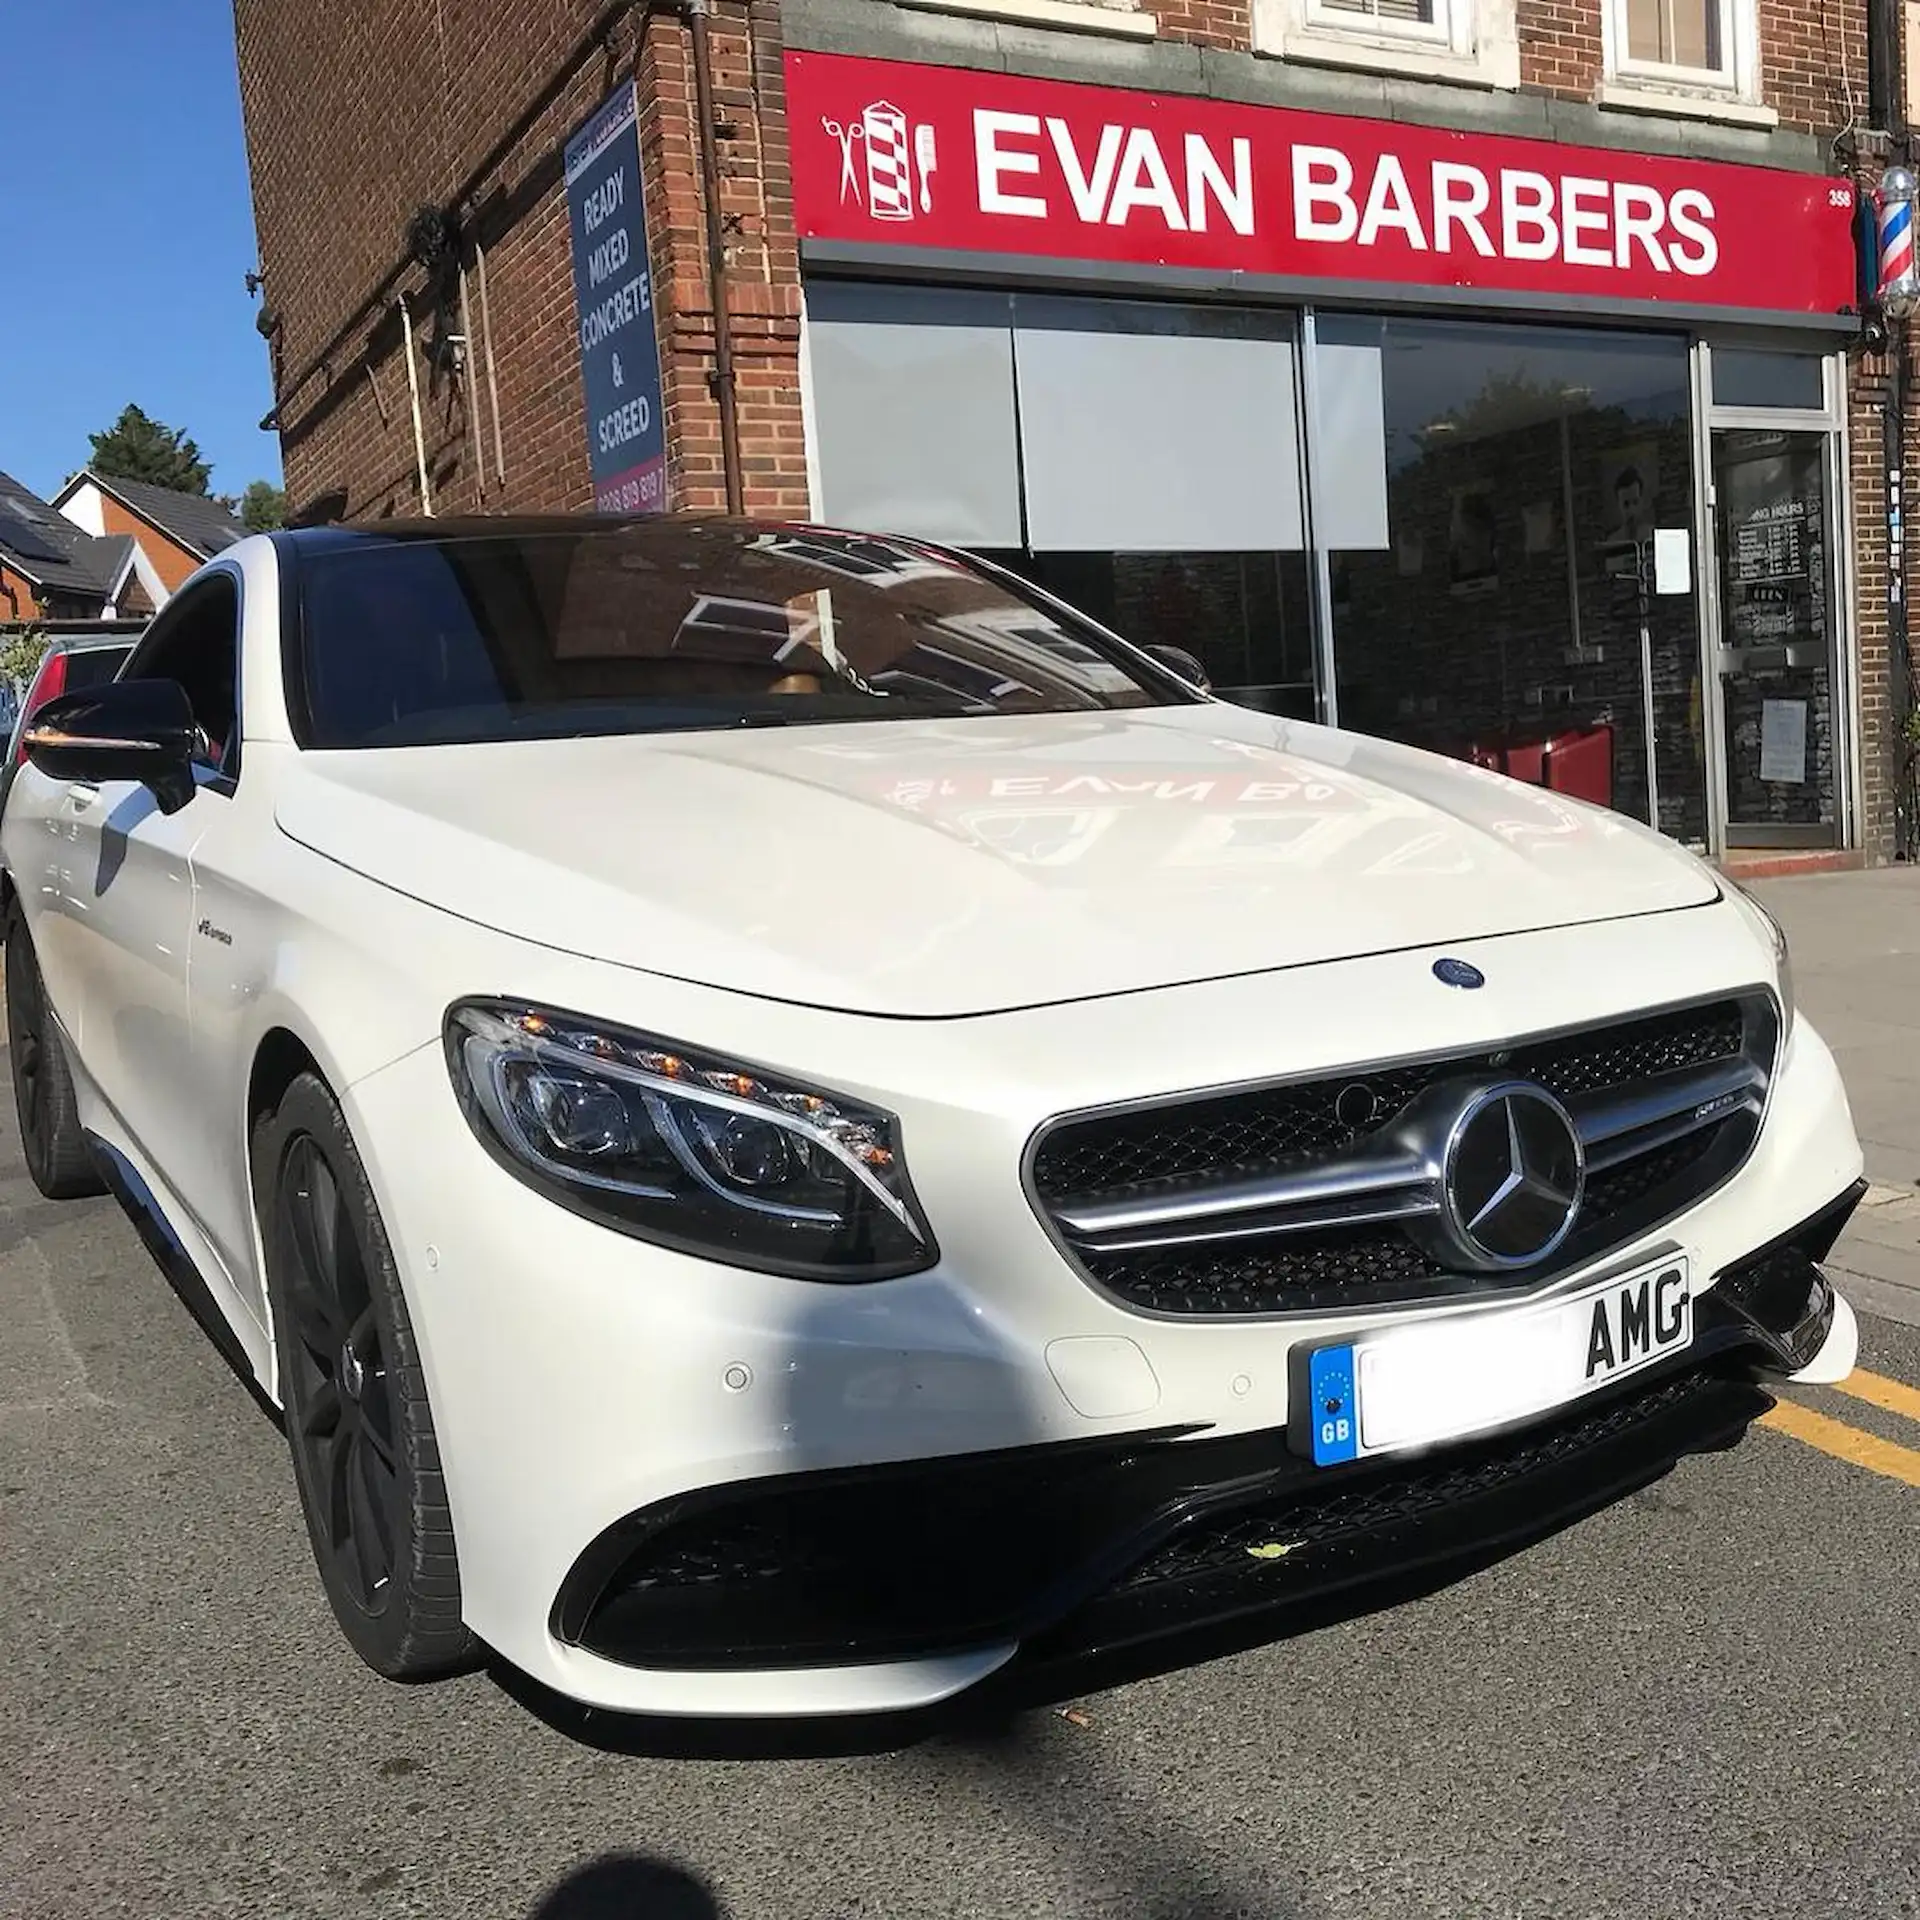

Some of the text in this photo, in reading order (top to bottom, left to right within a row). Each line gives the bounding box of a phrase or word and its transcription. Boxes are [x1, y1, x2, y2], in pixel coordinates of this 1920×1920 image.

[583, 165, 624, 236] READY
[973, 108, 1719, 277] EVAN BARBERS
[1828, 189, 1852, 207] 358
[587, 228, 629, 290] MIXED
[581, 271, 651, 351] CONCRETE
[612, 352, 624, 388] &
[599, 395, 650, 453] SCREED
[1585, 1269, 1685, 1378] AMG
[1321, 1419, 1349, 1444] GB
